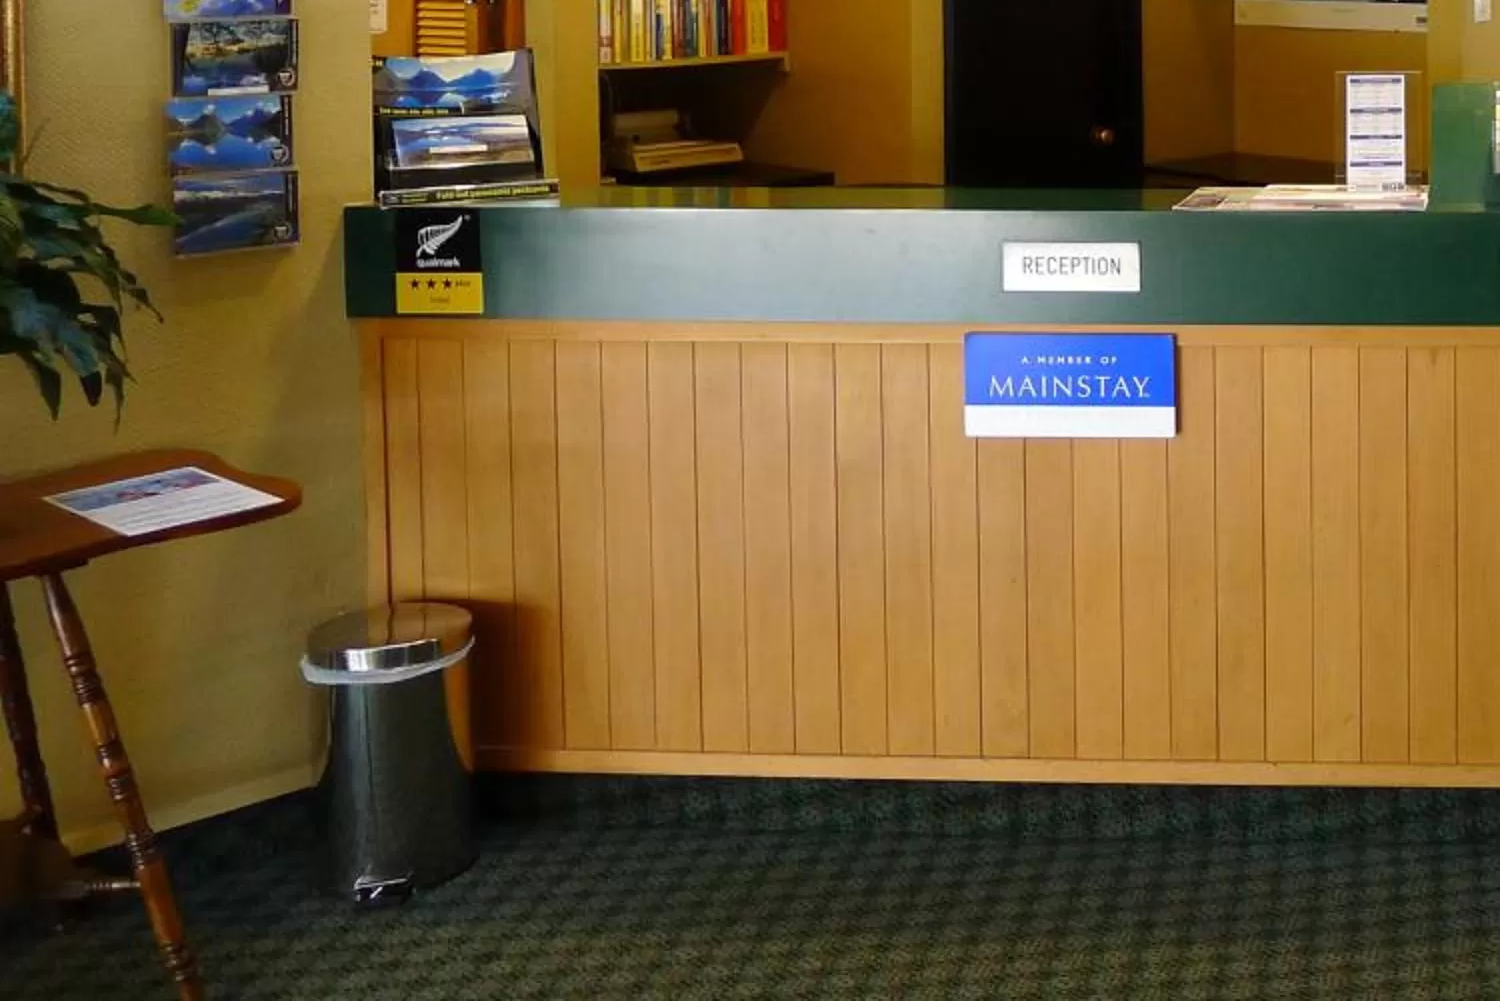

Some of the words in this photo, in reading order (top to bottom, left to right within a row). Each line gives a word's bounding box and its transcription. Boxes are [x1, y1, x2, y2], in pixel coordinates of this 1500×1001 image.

[1022, 256, 1122, 276] RECEPTION
[1020, 355, 1031, 366] A
[1036, 355, 1093, 366] MEMBER
[1099, 355, 1119, 366] OF
[988, 374, 1151, 399] MAINSTAY
